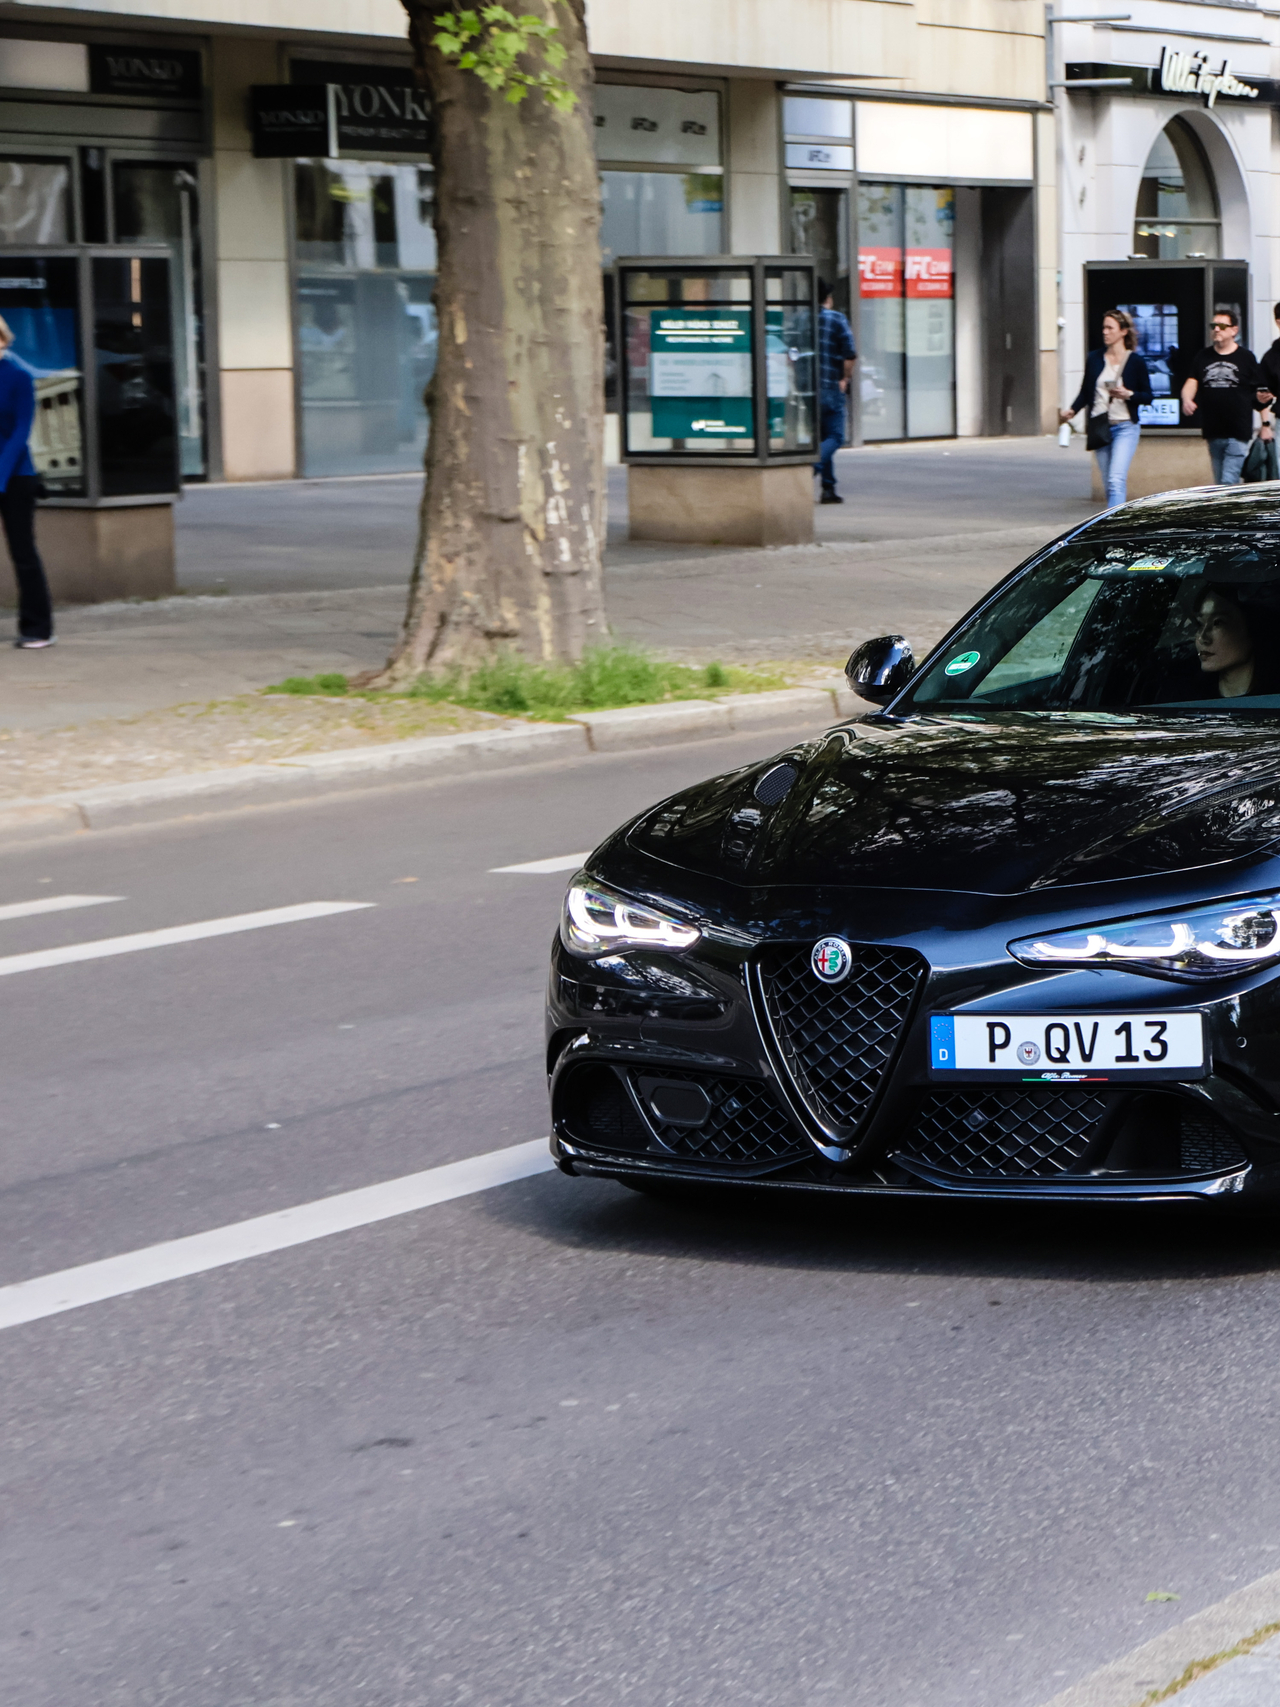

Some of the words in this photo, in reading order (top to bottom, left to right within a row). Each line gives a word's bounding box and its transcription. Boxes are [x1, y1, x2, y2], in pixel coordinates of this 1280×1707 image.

[986, 1021, 1012, 1063] P
[1044, 1021, 1100, 1064] QV
[1114, 1020, 1169, 1063] 13
[938, 1048, 949, 1061] D
[1041, 1071, 1061, 1081] Alfa
[1060, 1071, 1088, 1080] Romeo
